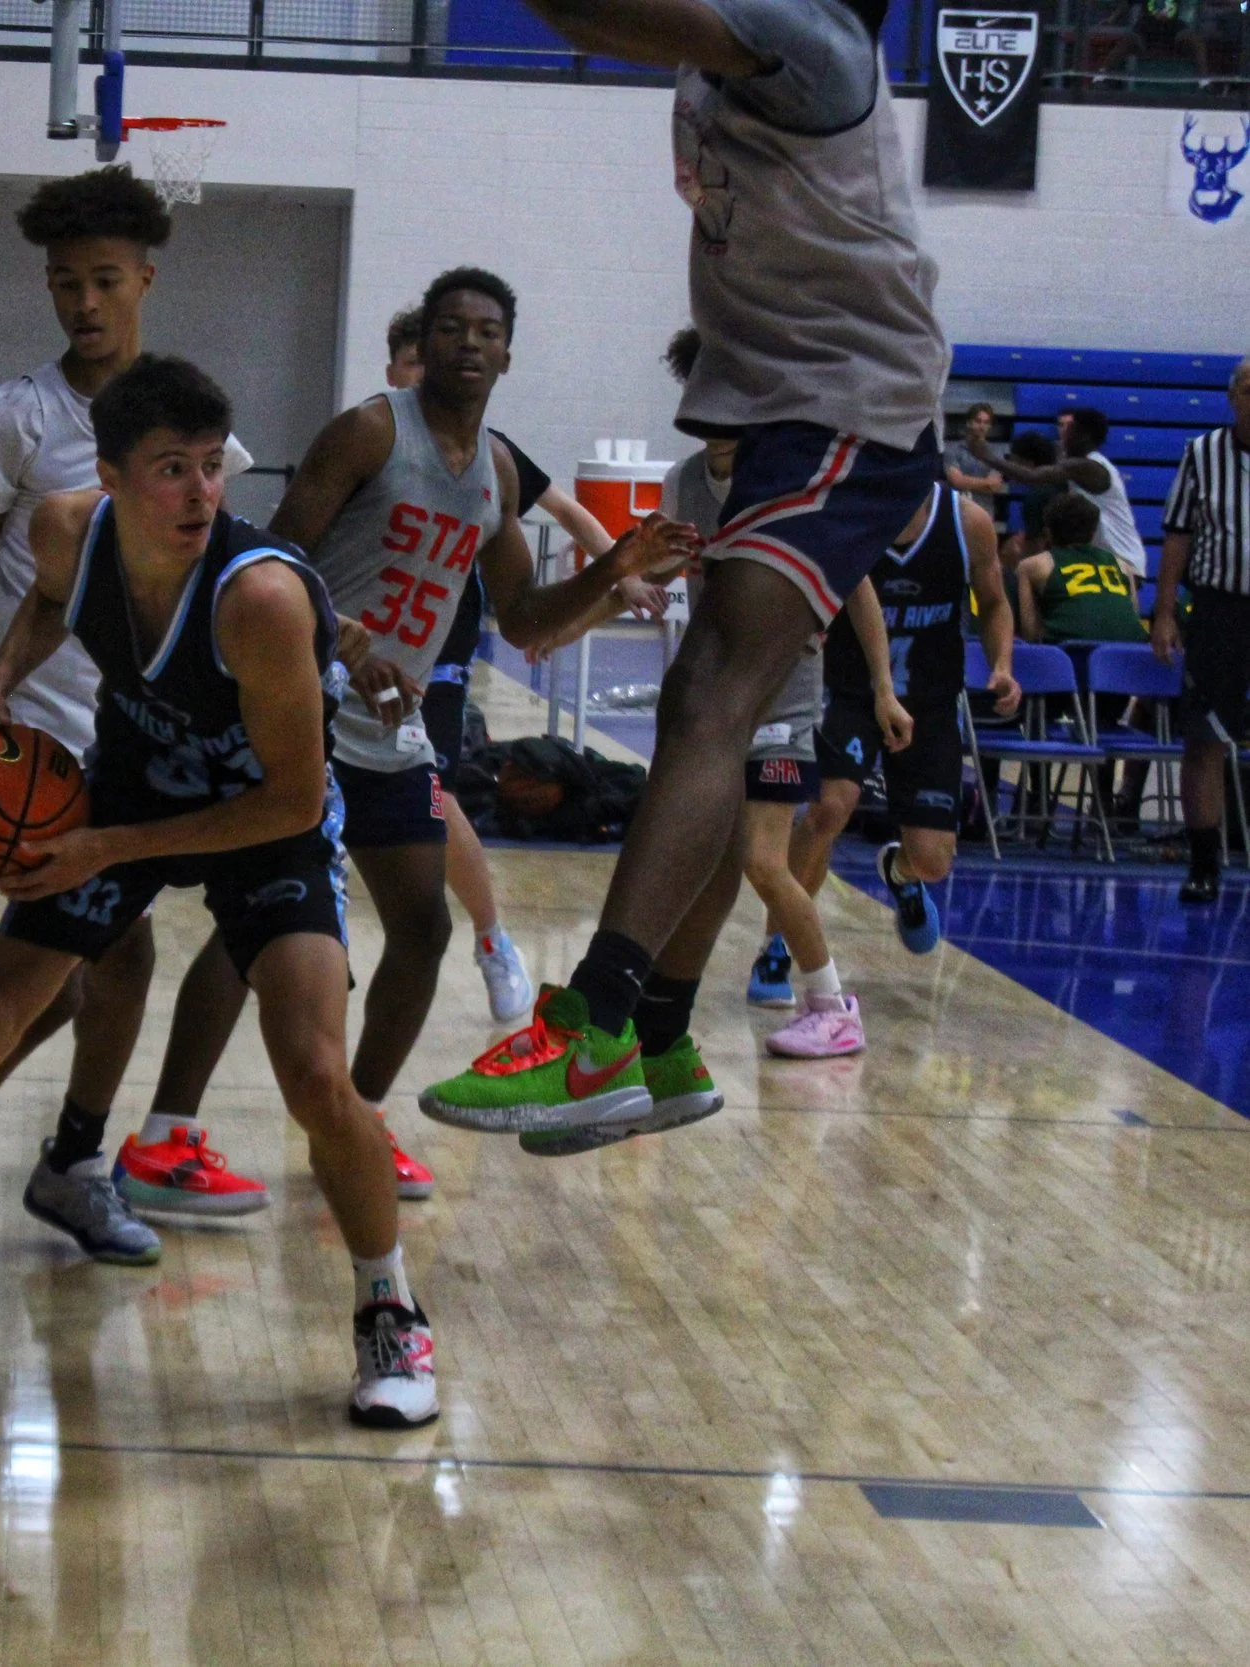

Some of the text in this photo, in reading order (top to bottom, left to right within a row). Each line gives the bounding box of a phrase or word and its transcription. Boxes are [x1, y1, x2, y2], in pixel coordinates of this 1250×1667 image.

[954, 31, 1017, 52] ELITE
[959, 57, 1010, 93] HS
[381, 502, 481, 574] STA
[1060, 562, 1128, 597] 20
[360, 565, 450, 648] 35
[846, 736, 865, 765] 4
